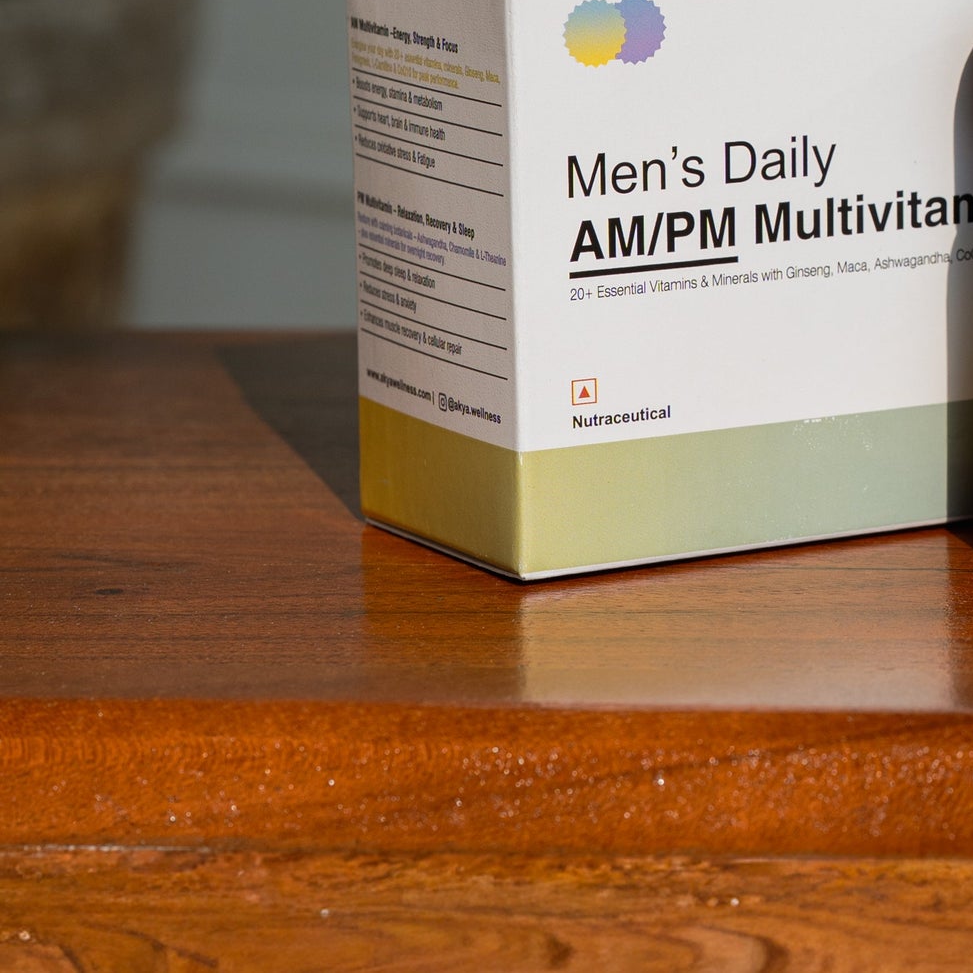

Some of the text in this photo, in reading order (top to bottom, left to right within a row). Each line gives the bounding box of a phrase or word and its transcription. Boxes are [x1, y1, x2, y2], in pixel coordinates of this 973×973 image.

[359, 18, 389, 37] Multivitamin
[412, 31, 435, 50] Strength
[437, 37, 441, 50] &
[441, 38, 459, 54] Focus
[485, 69, 500, 84] Maca,
[371, 83, 387, 99] energy,
[388, 86, 408, 103] stamina
[408, 91, 413, 104] &
[413, 93, 443, 112] metabolism
[357, 105, 377, 123] Supports
[391, 113, 403, 129] brain
[404, 119, 409, 132] &
[408, 120, 429, 137] immune
[429, 125, 446, 141] health
[397, 146, 412, 162] stress
[412, 150, 417, 163] &
[417, 151, 436, 170] Fatigue
[567, 134, 837, 199] Men's Daily
[365, 193, 393, 214] Multivitamin
[397, 204, 425, 226] Relaxation,
[425, 213, 451, 235] Recovery
[452, 221, 457, 233] &
[458, 222, 475, 242] Sleep
[569, 206, 736, 263] AM/PM
[416, 231, 449, 252] Ashwagandha,
[448, 241, 475, 259] Chamomile
[475, 248, 480, 260] &
[480, 249, 507, 267] L-Theanine
[394, 264, 407, 280] sleep
[407, 269, 411, 282] &
[412, 270, 436, 290] relaxation
[569, 287, 593, 301] 20+
[597, 281, 647, 299] Essential
[650, 277, 698, 294] Vitamins
[700, 274, 710, 289] &
[712, 269, 759, 287] Minerals
[761, 266, 784, 281] with
[785, 260, 834, 280] Ginseng,
[837, 260, 871, 274] Maca,
[874, 250, 954, 271] Ashwagandha,
[381, 288, 396, 305] stress
[396, 293, 400, 306] &
[400, 295, 417, 314] anxiety
[384, 315, 401, 333] muscle
[401, 325, 422, 345] recovery
[422, 332, 427, 345] &
[427, 333, 446, 350] cellular
[447, 342, 463, 356] repair
[448, 396, 502, 424] @akya.wellness
[572, 405, 671, 430] Nutraceutical
